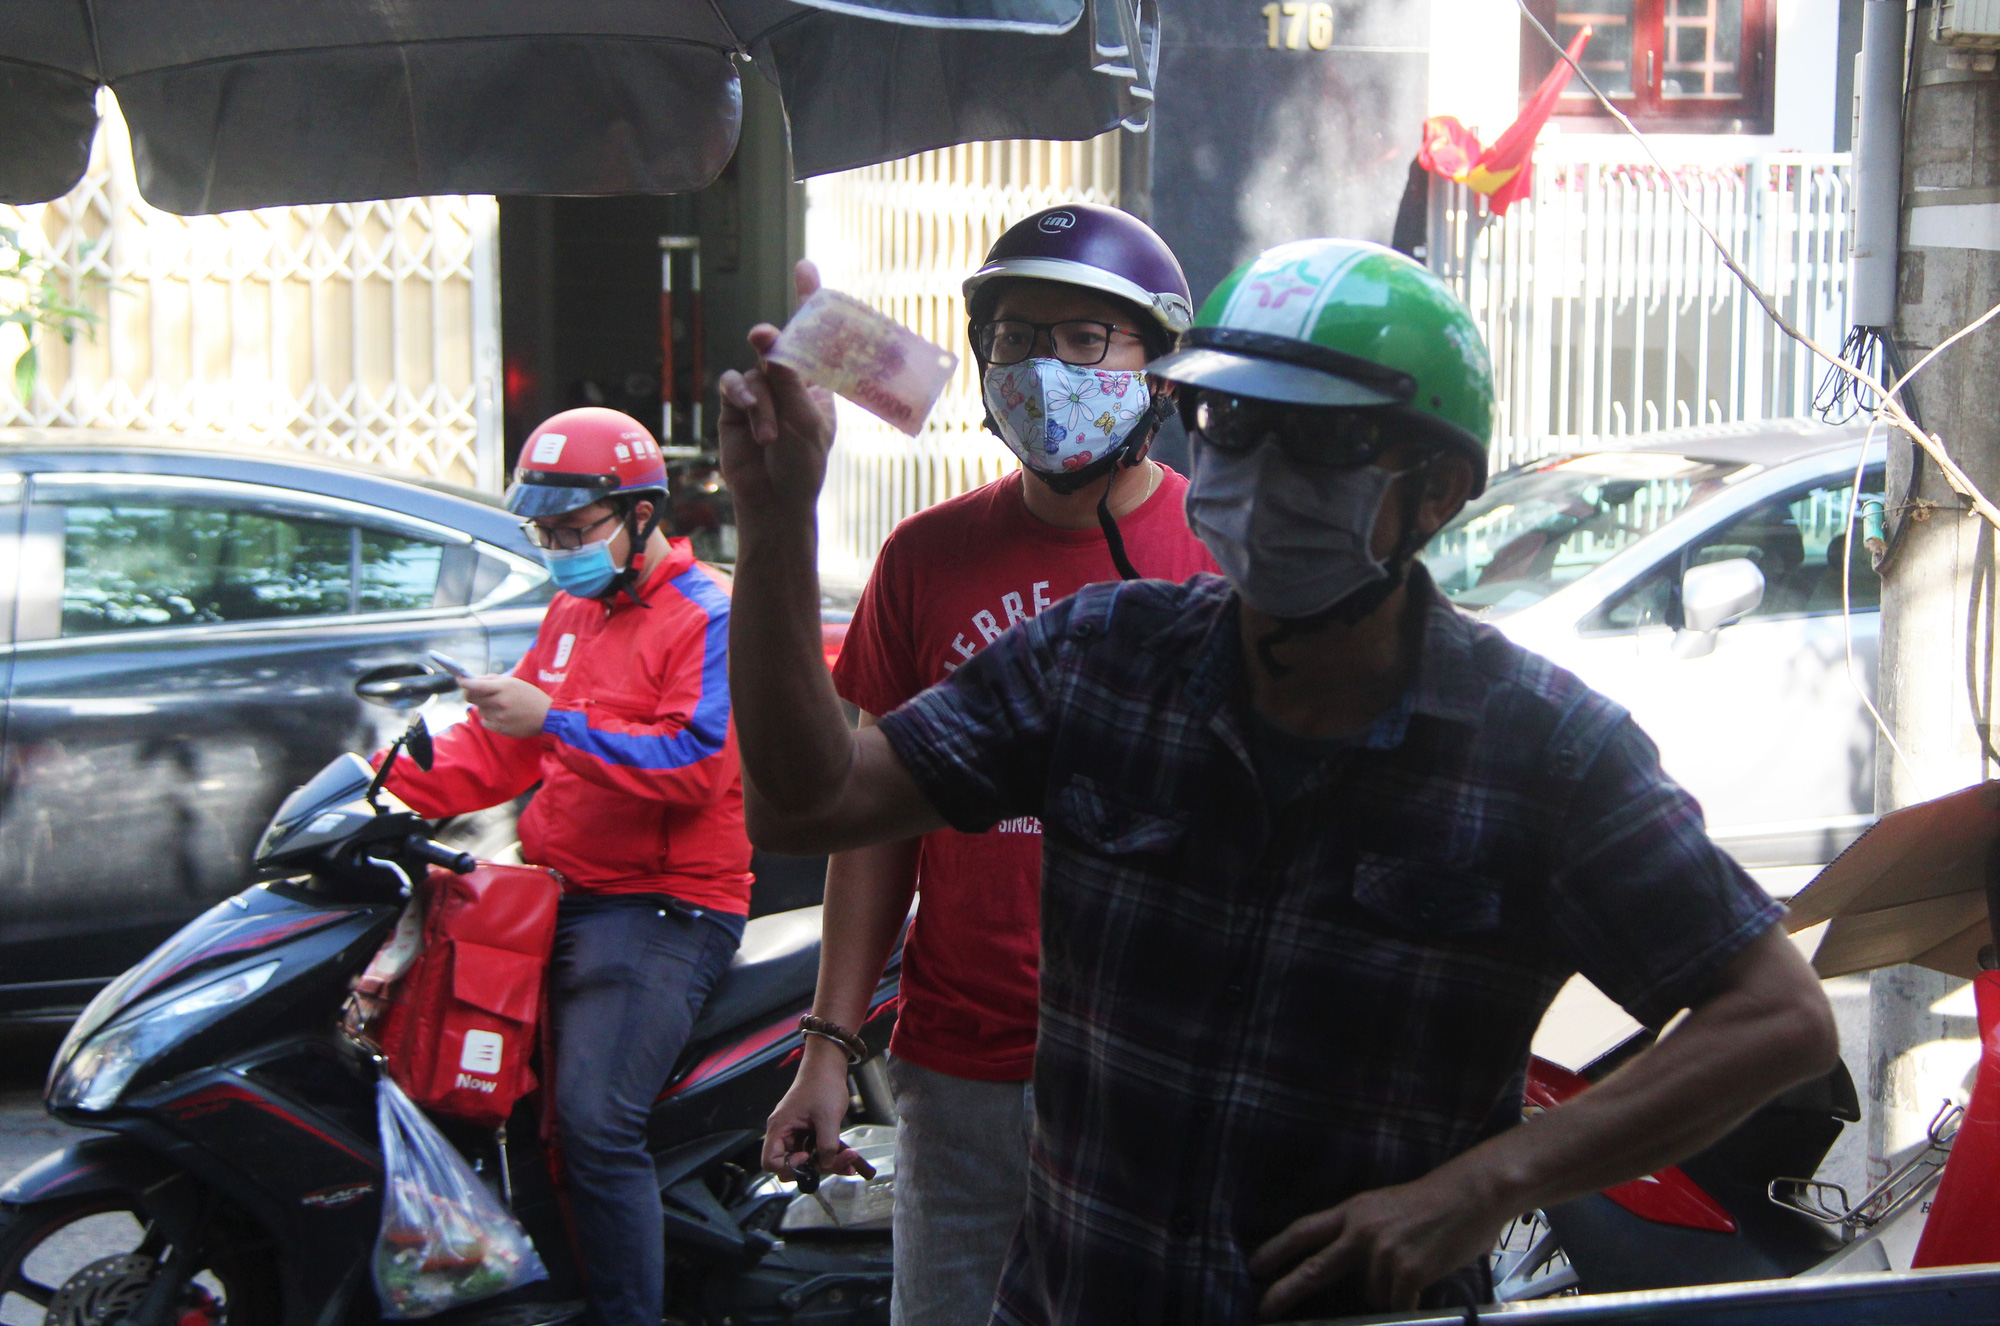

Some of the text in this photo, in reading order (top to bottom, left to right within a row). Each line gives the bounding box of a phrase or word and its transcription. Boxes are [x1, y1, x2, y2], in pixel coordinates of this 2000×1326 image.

[1262, 2, 1334, 50] 176
[998, 816, 1042, 834] SINCE
[454, 1073, 498, 1094] Now
